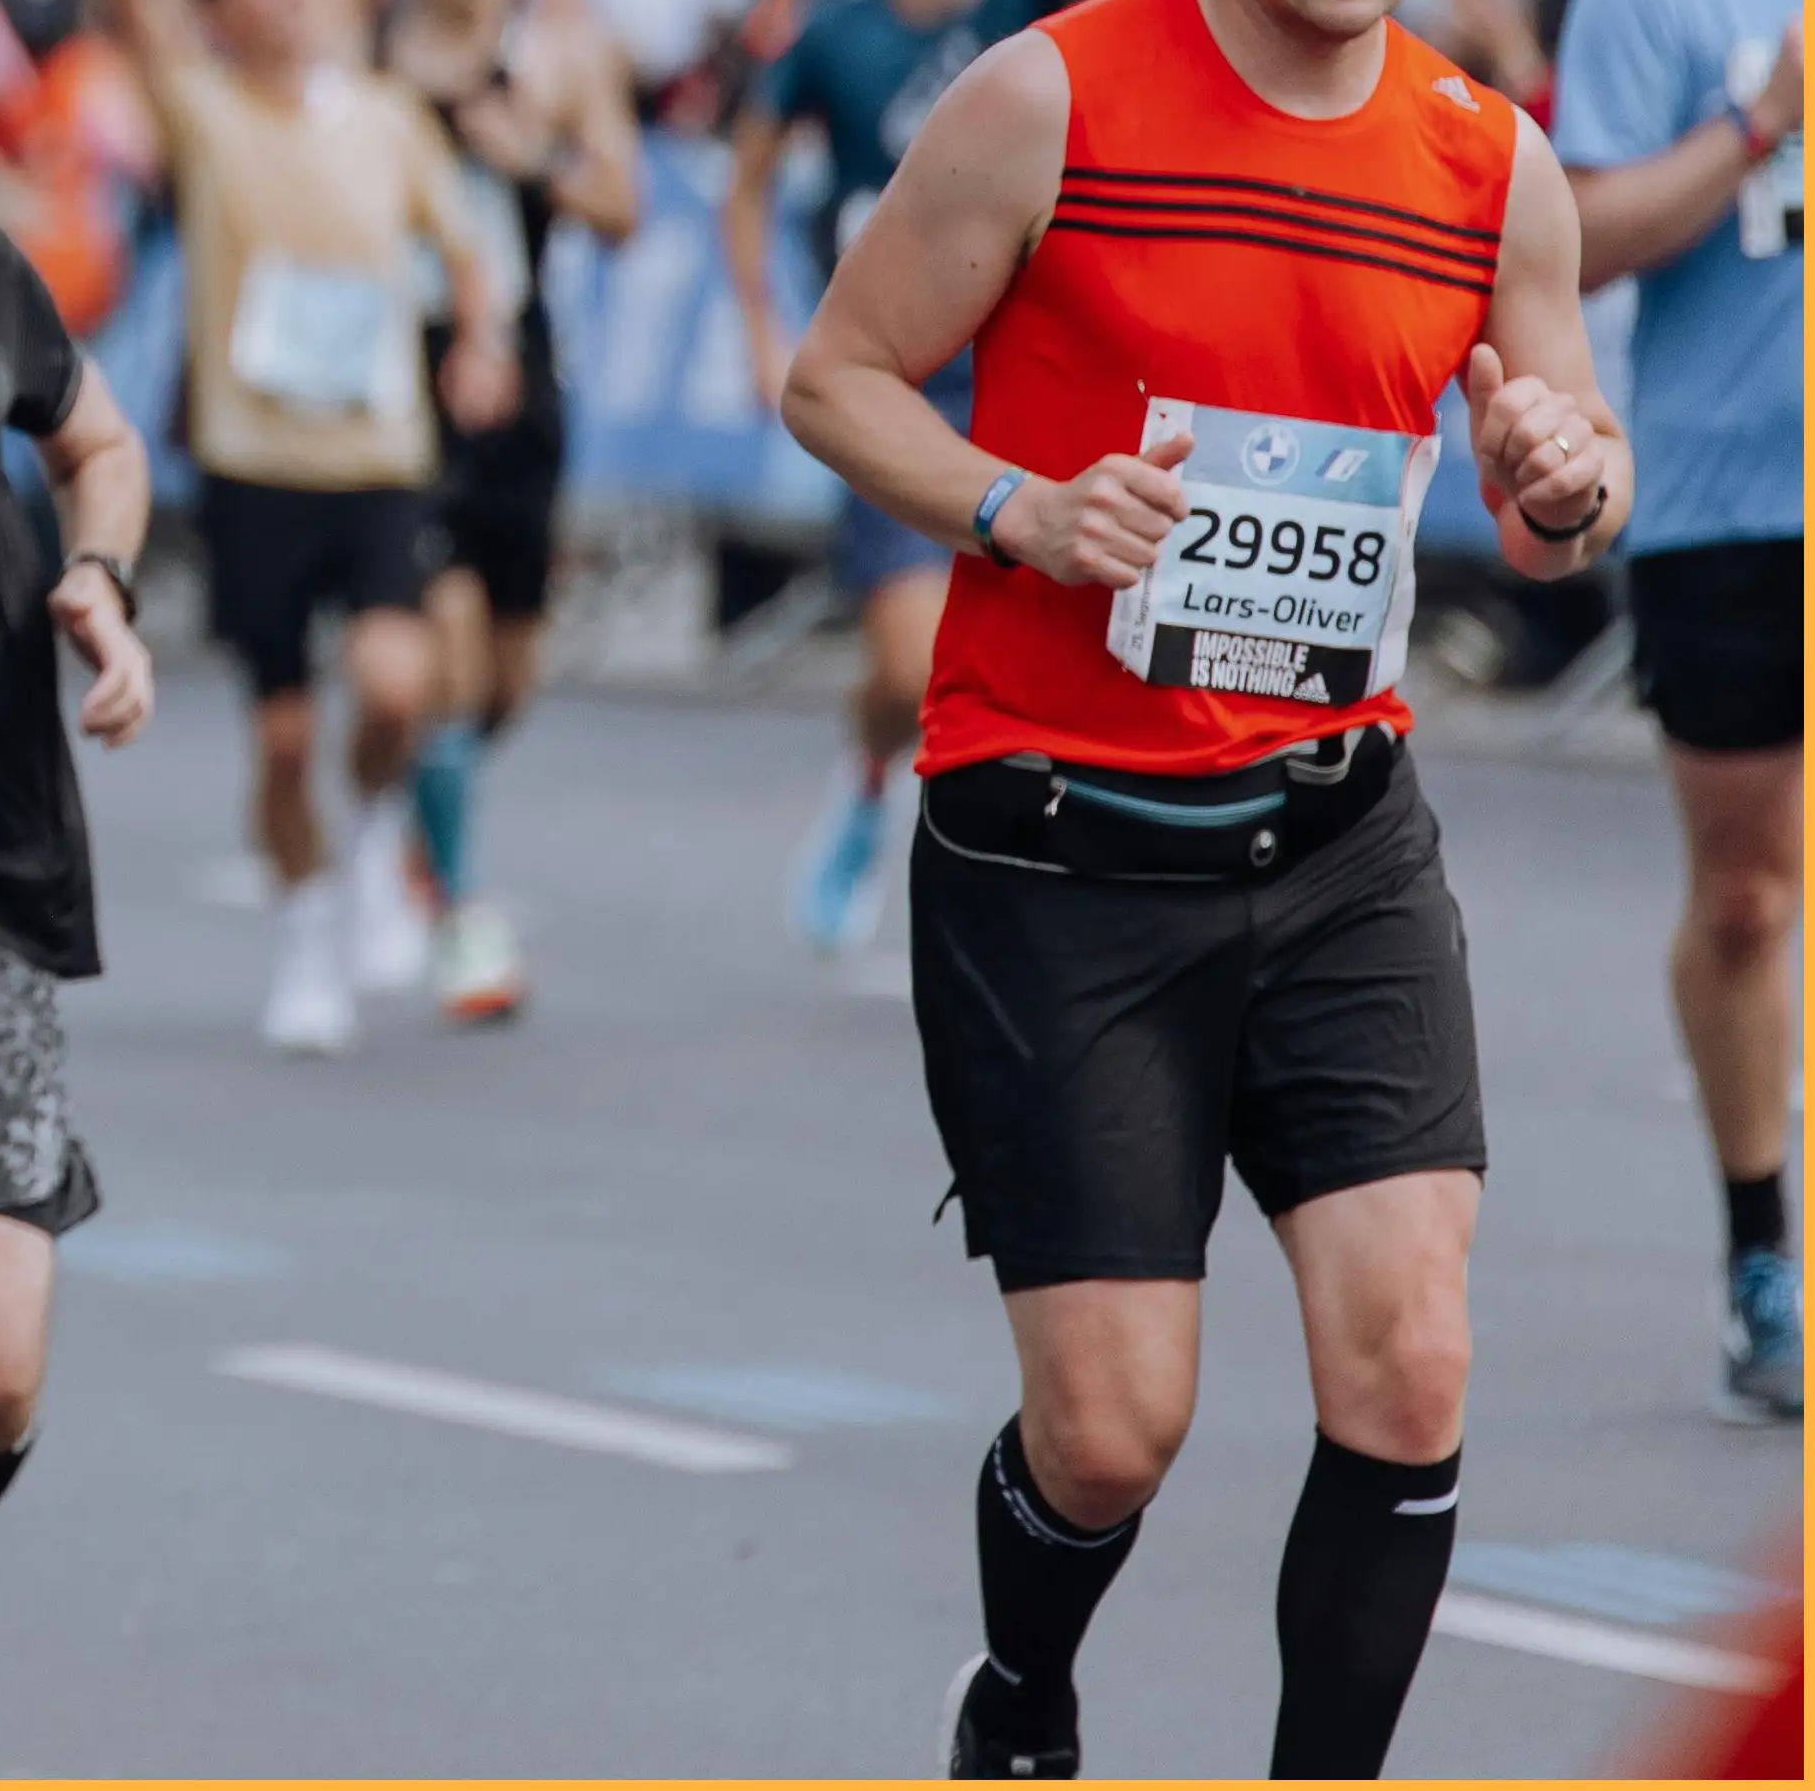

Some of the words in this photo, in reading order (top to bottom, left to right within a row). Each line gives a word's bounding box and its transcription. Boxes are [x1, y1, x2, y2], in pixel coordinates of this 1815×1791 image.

[1179, 509, 1386, 587] 29958
[1184, 583, 1365, 634] Lars-Oliver
[1193, 630, 1310, 673] IMPOSSIBLE
[1190, 657, 1210, 687] IS
[1211, 660, 1297, 697] NOTHING
